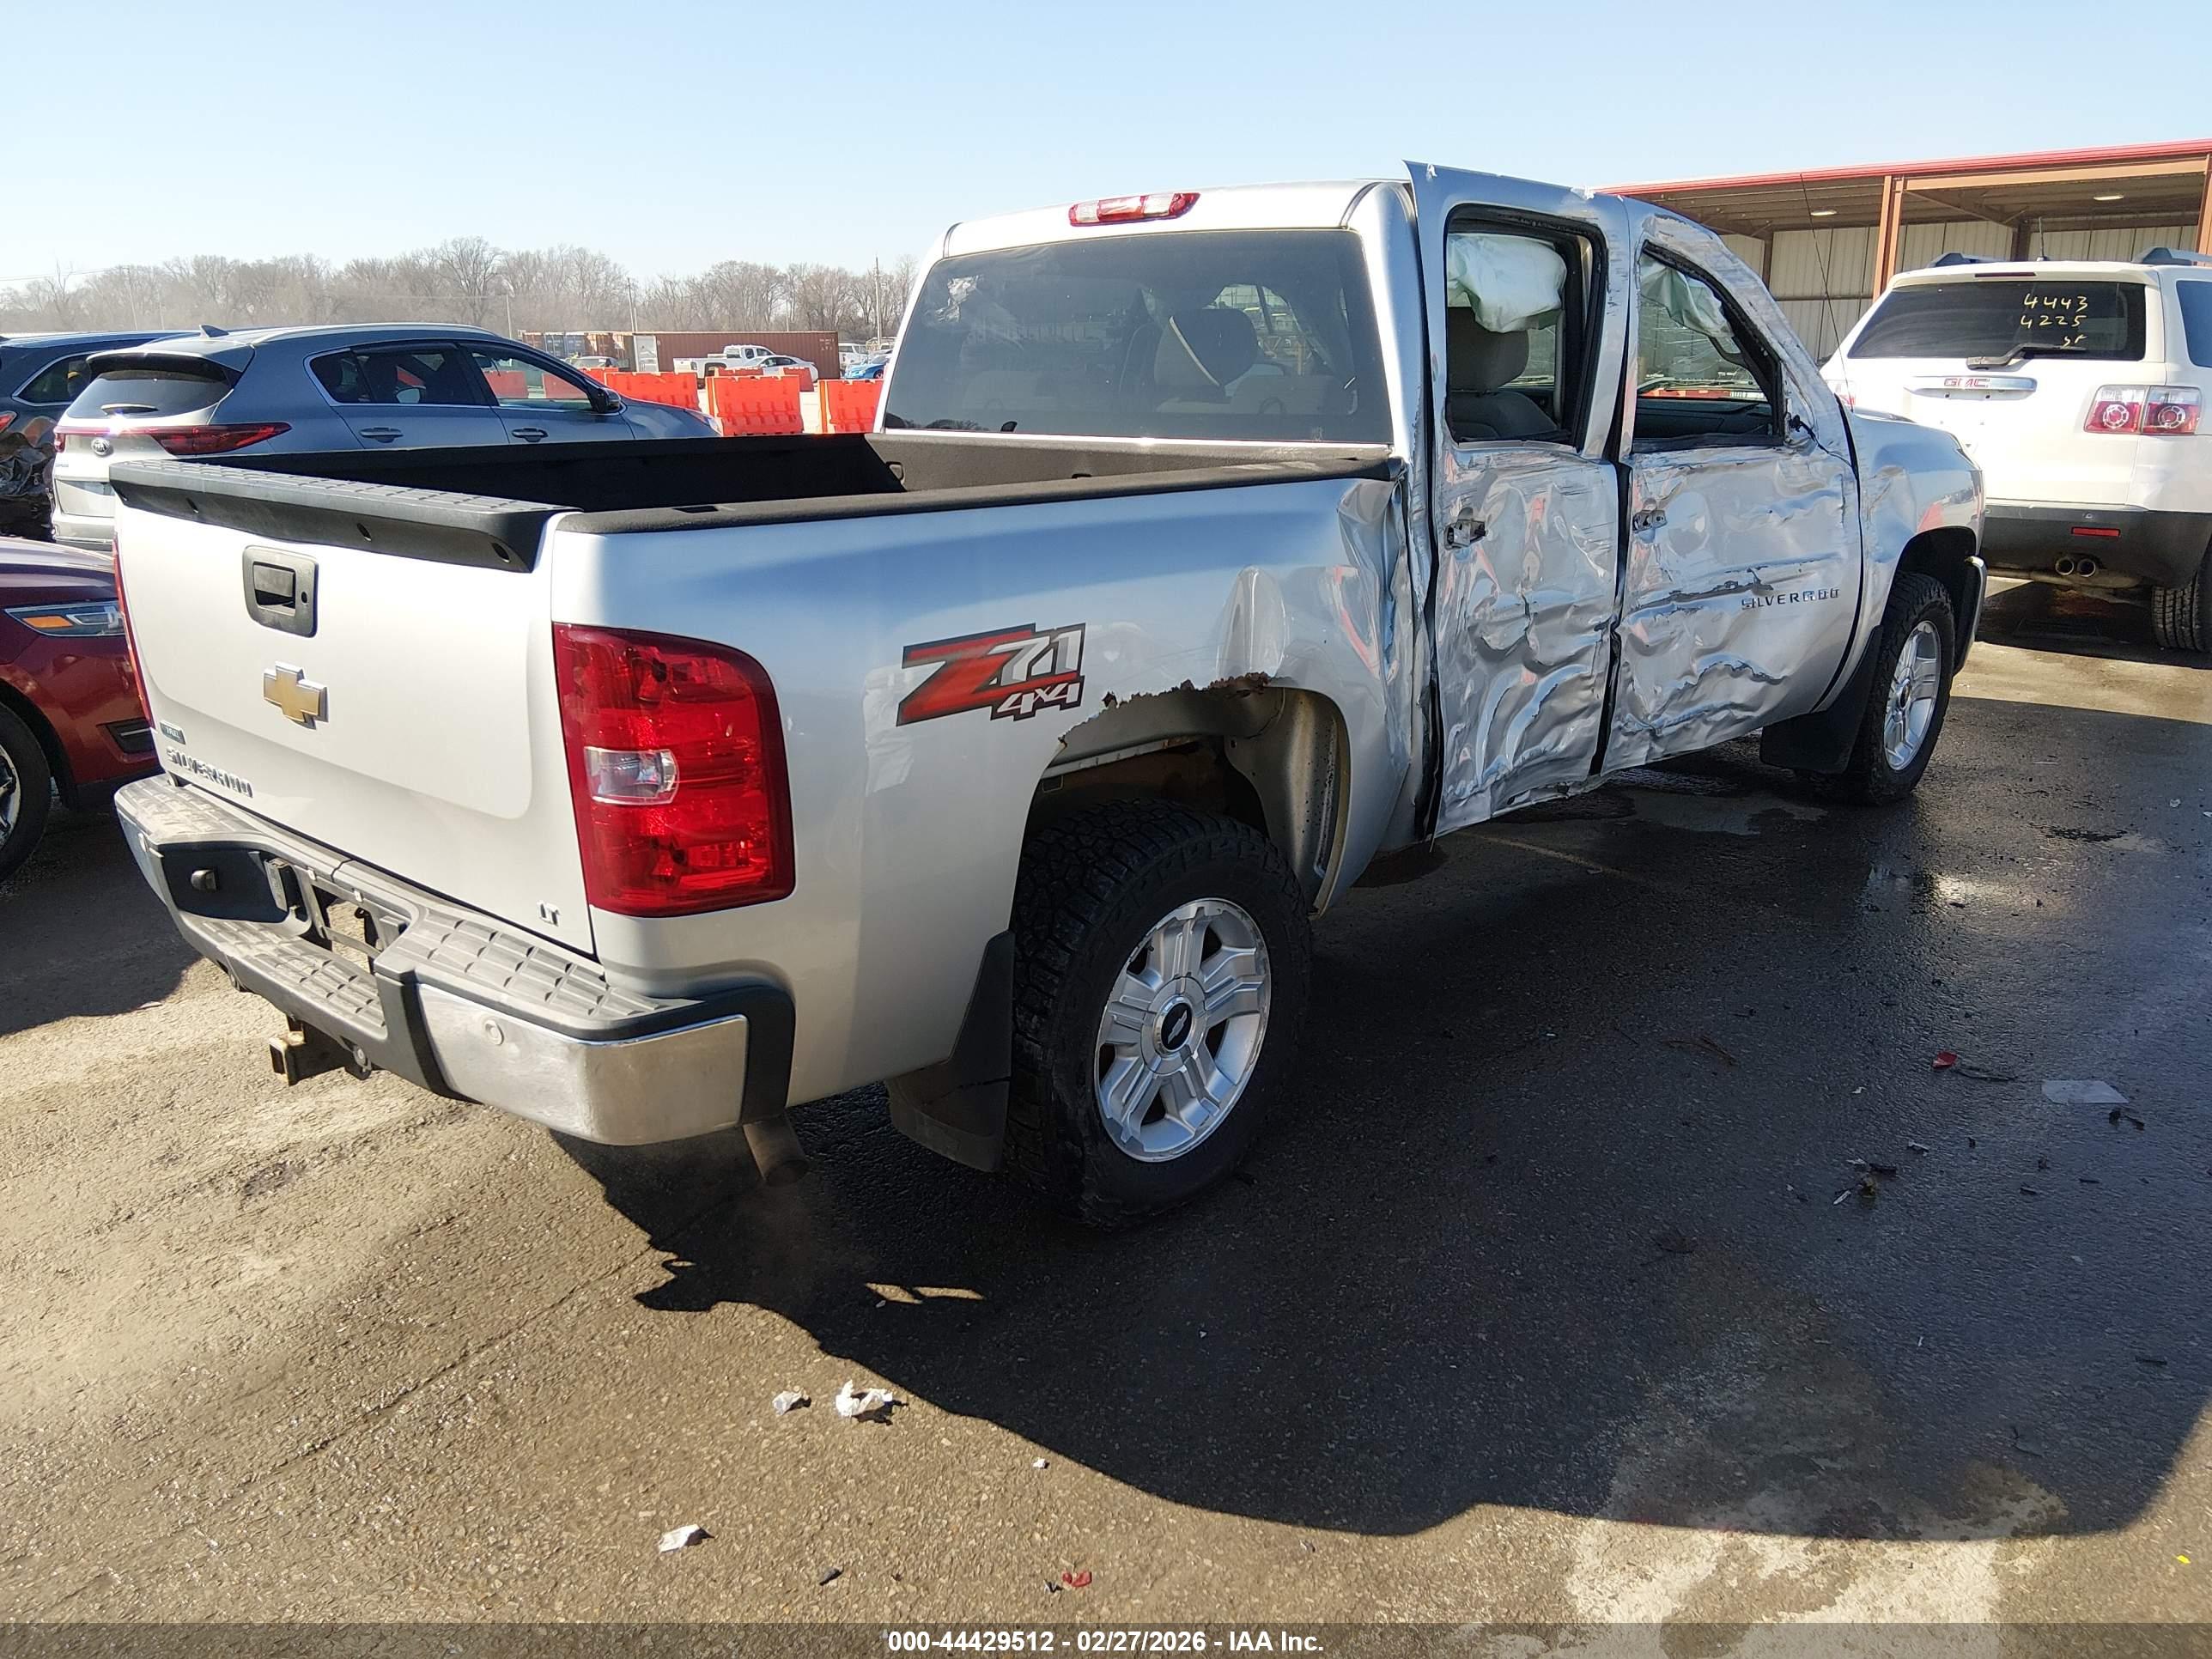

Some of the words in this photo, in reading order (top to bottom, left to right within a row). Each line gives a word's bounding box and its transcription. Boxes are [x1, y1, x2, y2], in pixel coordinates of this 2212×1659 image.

[2024, 293, 2088, 313] 4443
[2020, 314, 2087, 328] 4225
[1944, 378, 1990, 387] GMC
[896, 623, 1085, 726] Z71
